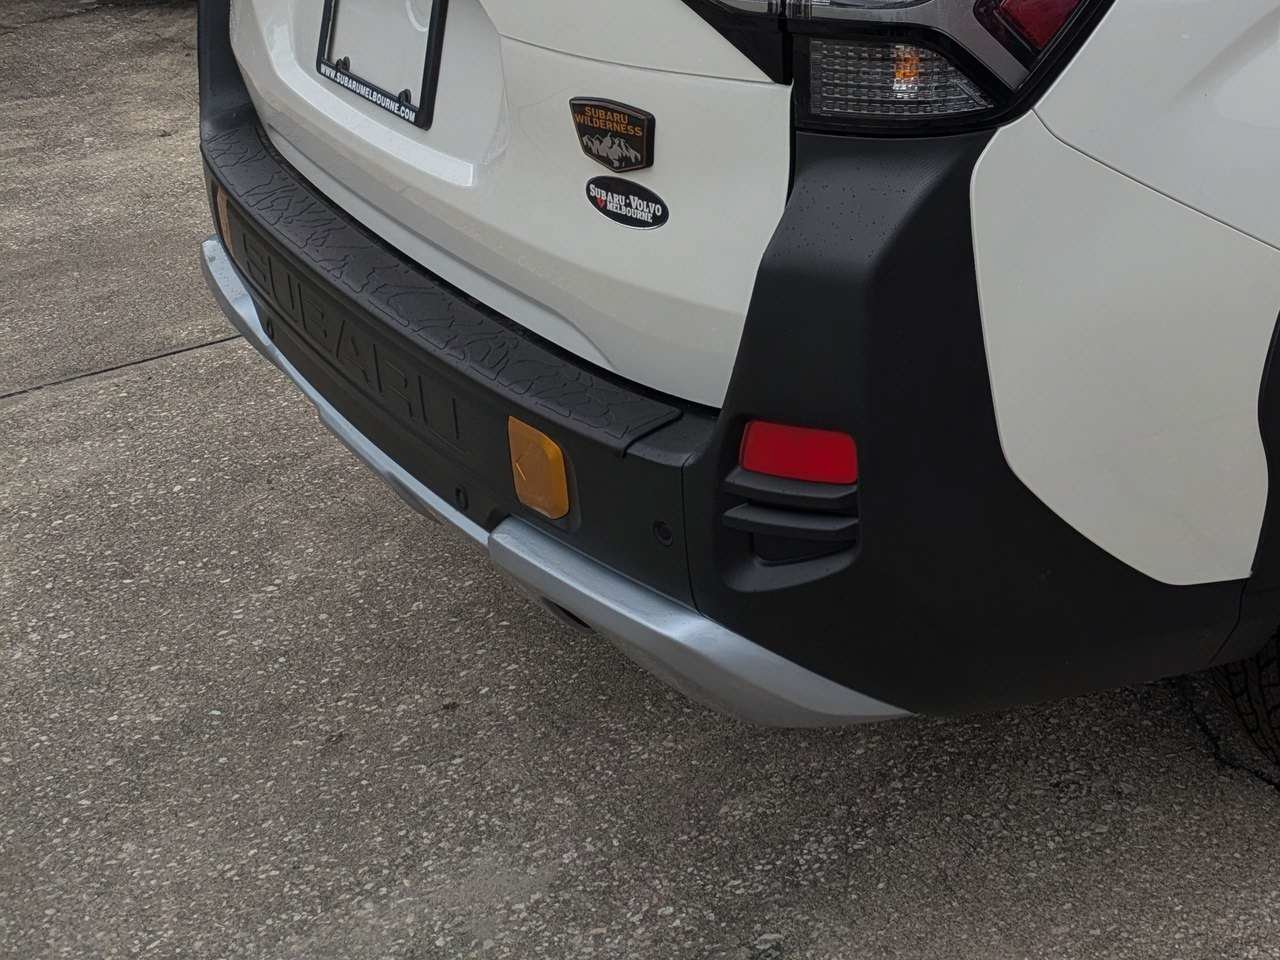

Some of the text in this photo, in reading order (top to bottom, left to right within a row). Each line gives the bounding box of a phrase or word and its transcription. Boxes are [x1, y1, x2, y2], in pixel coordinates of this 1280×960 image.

[320, 65, 416, 123] WWW.SUBARUMELBOURNE.COM
[575, 113, 643, 137] WILDERNESS
[584, 106, 629, 124] SUBARU
[589, 183, 662, 216] SUBARU VOLVO
[606, 202, 653, 223] MELBOURNE
